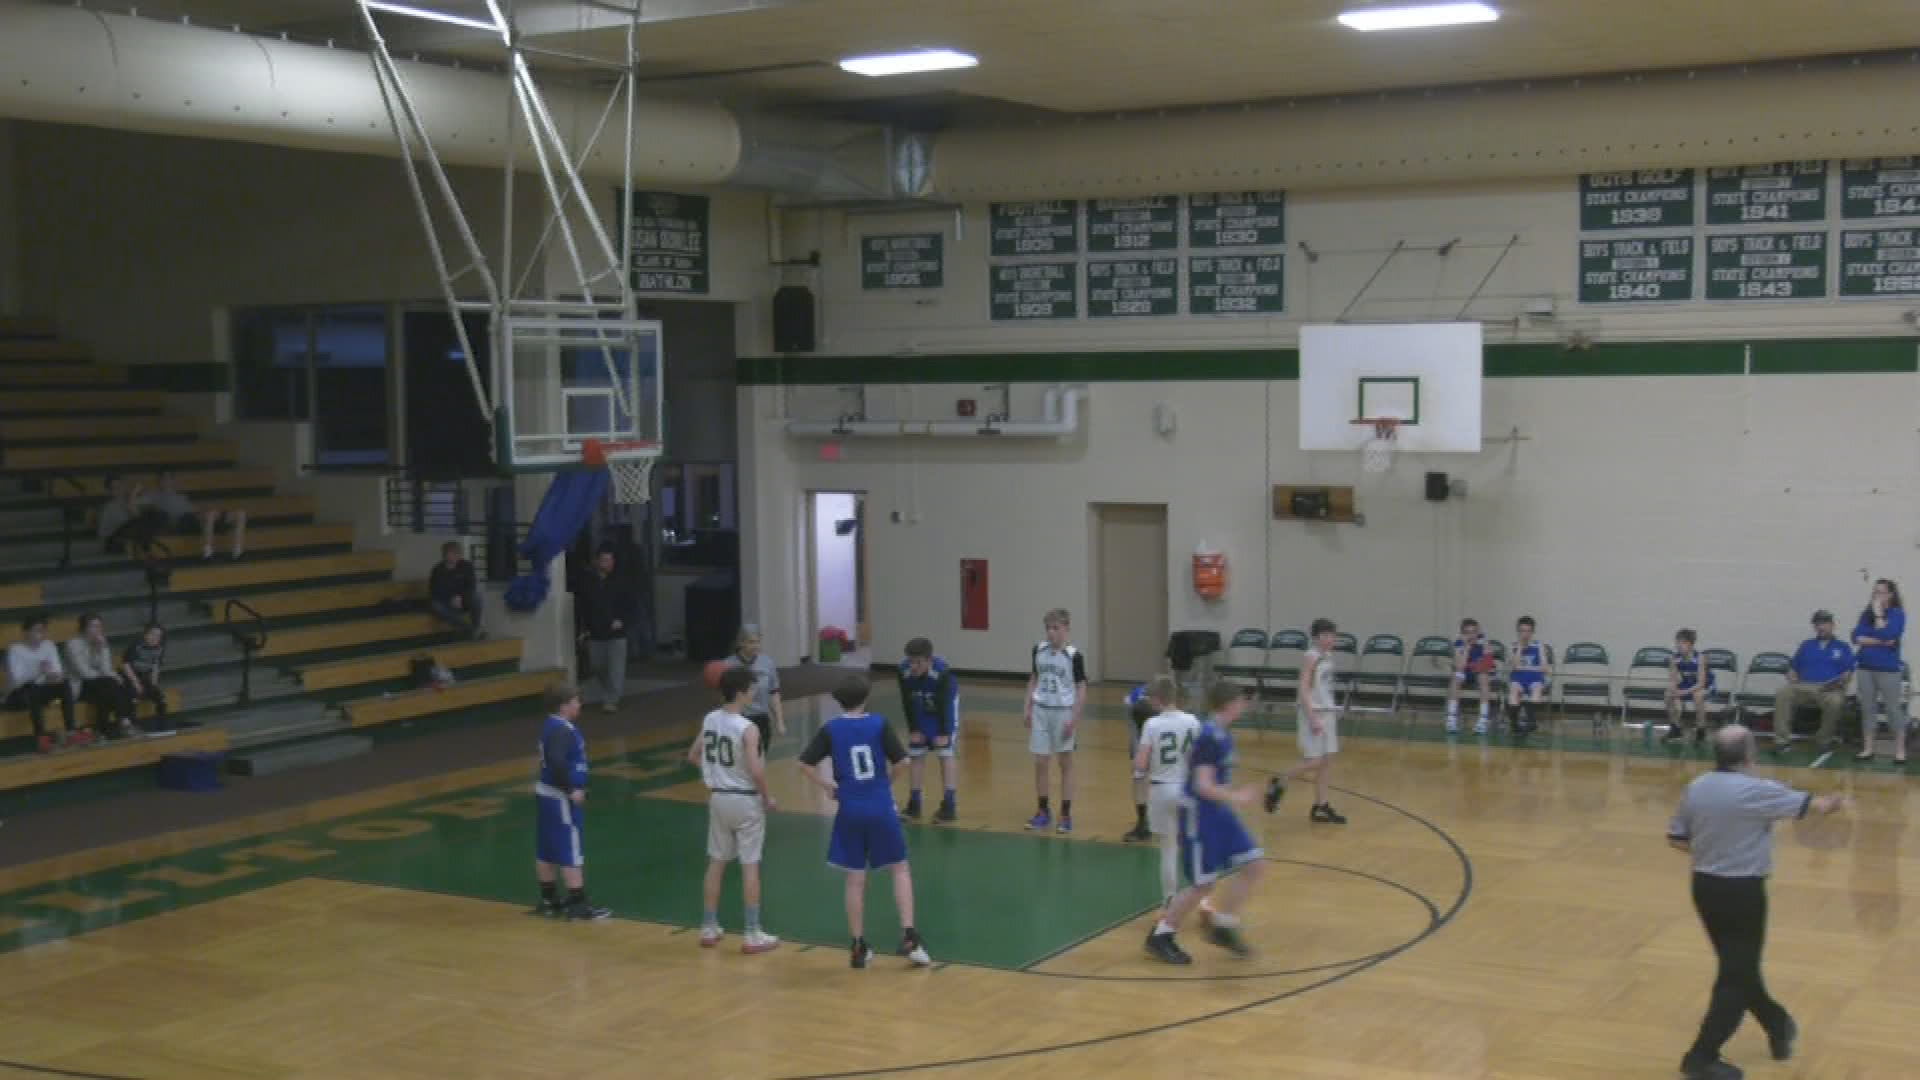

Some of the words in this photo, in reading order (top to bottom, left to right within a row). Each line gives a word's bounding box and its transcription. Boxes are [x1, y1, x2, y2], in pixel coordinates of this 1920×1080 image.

[1585, 192, 1621, 206] STATE
[704, 730, 734, 767] 20
[851, 744, 874, 780] 0
